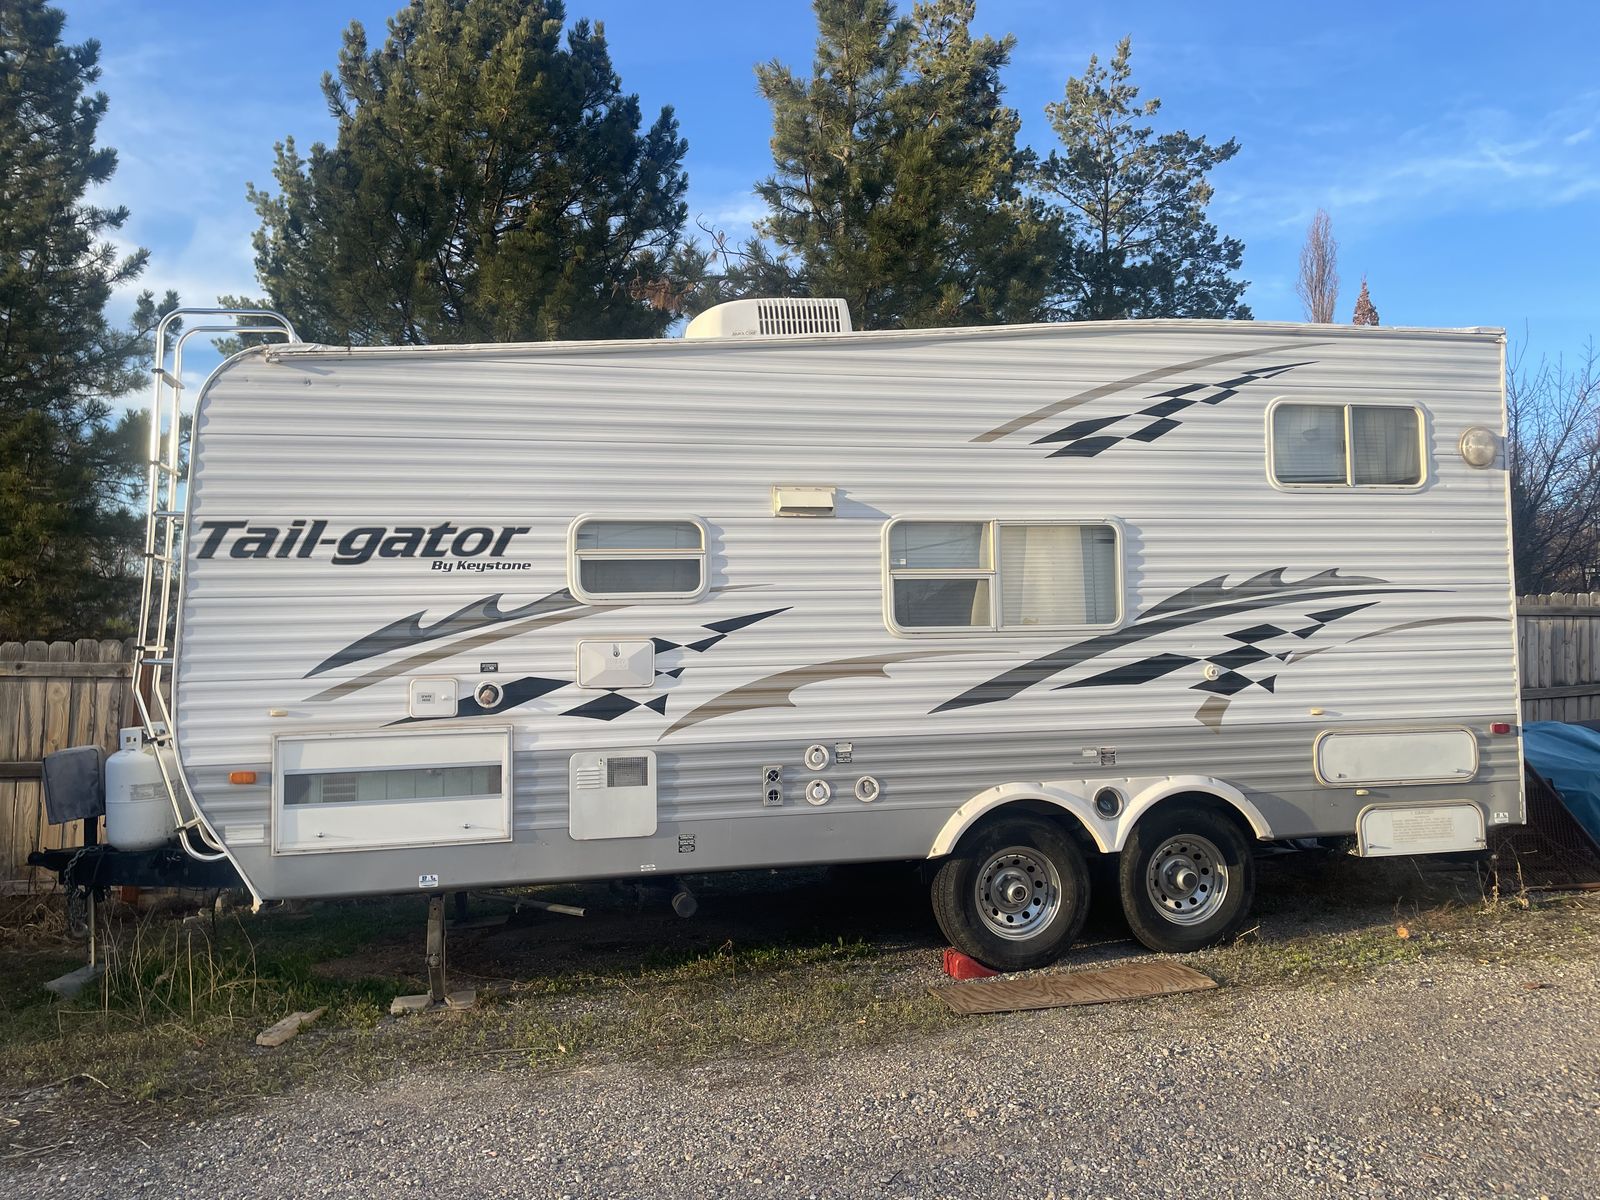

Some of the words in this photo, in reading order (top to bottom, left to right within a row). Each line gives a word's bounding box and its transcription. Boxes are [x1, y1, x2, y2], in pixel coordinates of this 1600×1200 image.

[196, 520, 531, 565] Tail-gator
[431, 560, 453, 573] By
[456, 560, 532, 573] Keystone
